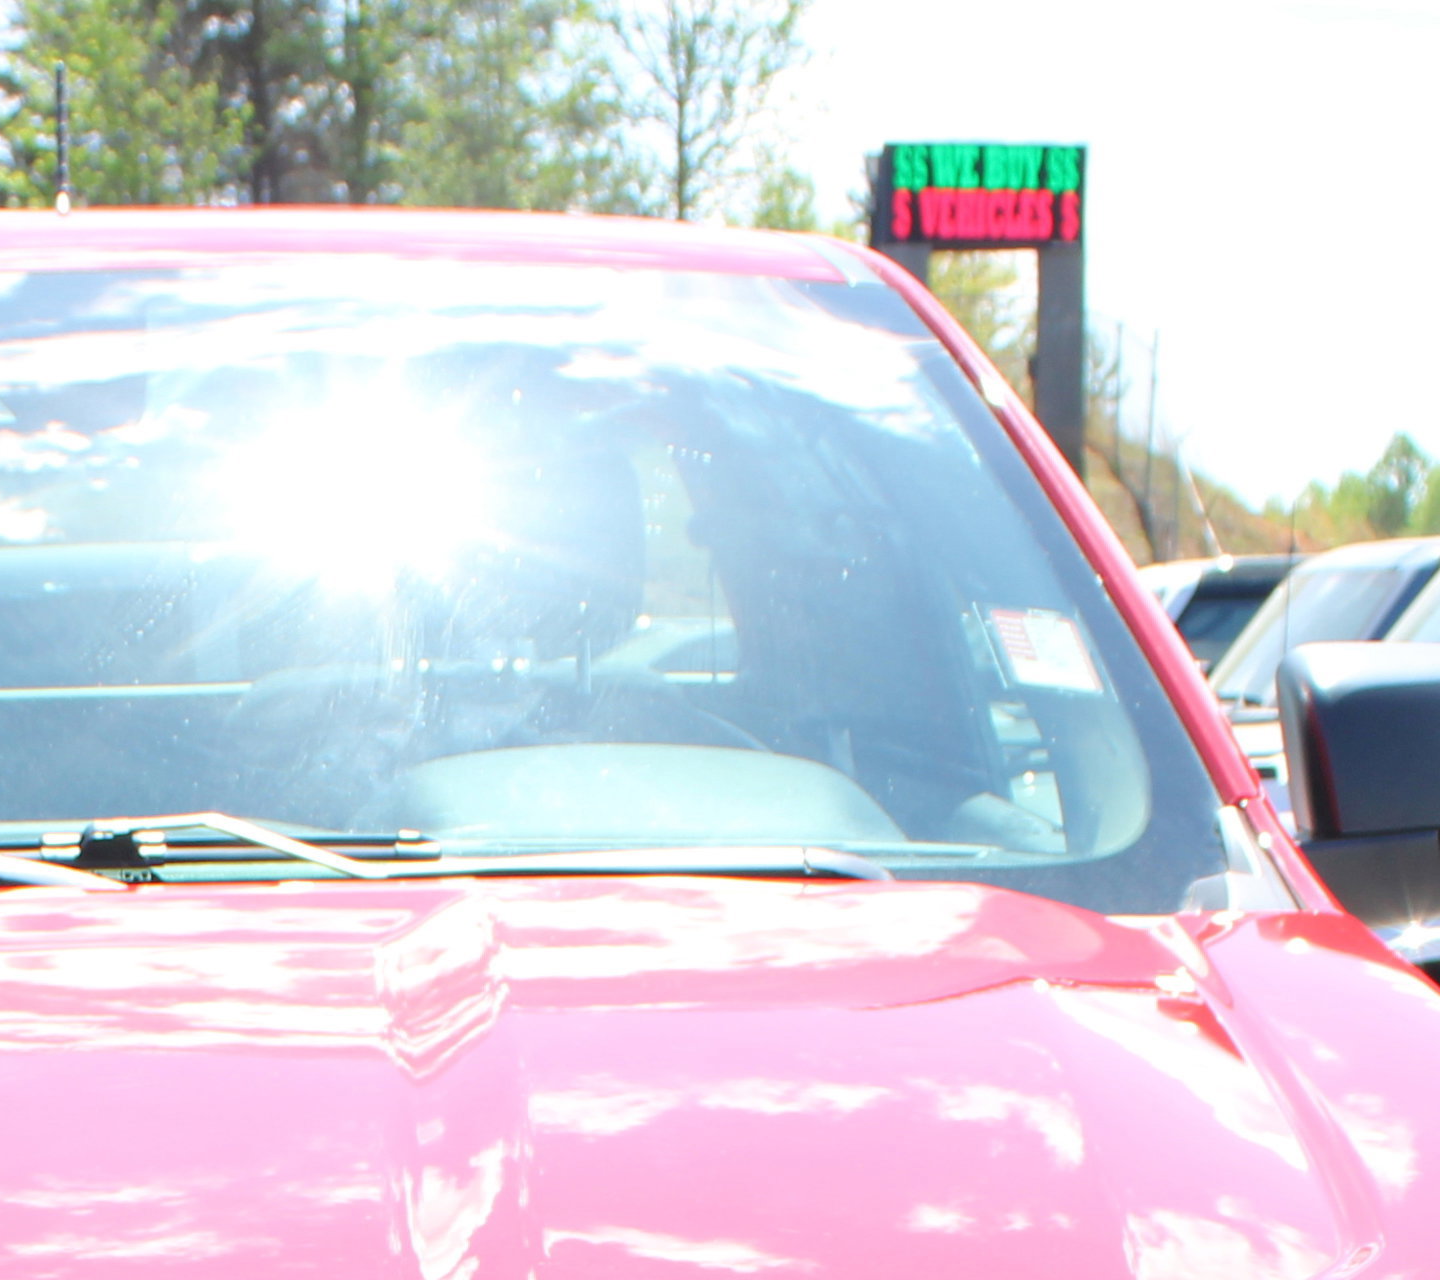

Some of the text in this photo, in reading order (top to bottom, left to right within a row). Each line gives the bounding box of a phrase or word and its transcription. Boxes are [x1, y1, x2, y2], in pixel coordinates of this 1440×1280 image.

[931, 144, 980, 189] WE
[983, 144, 1043, 190] BUY
[919, 187, 1055, 239] VEHICLES
